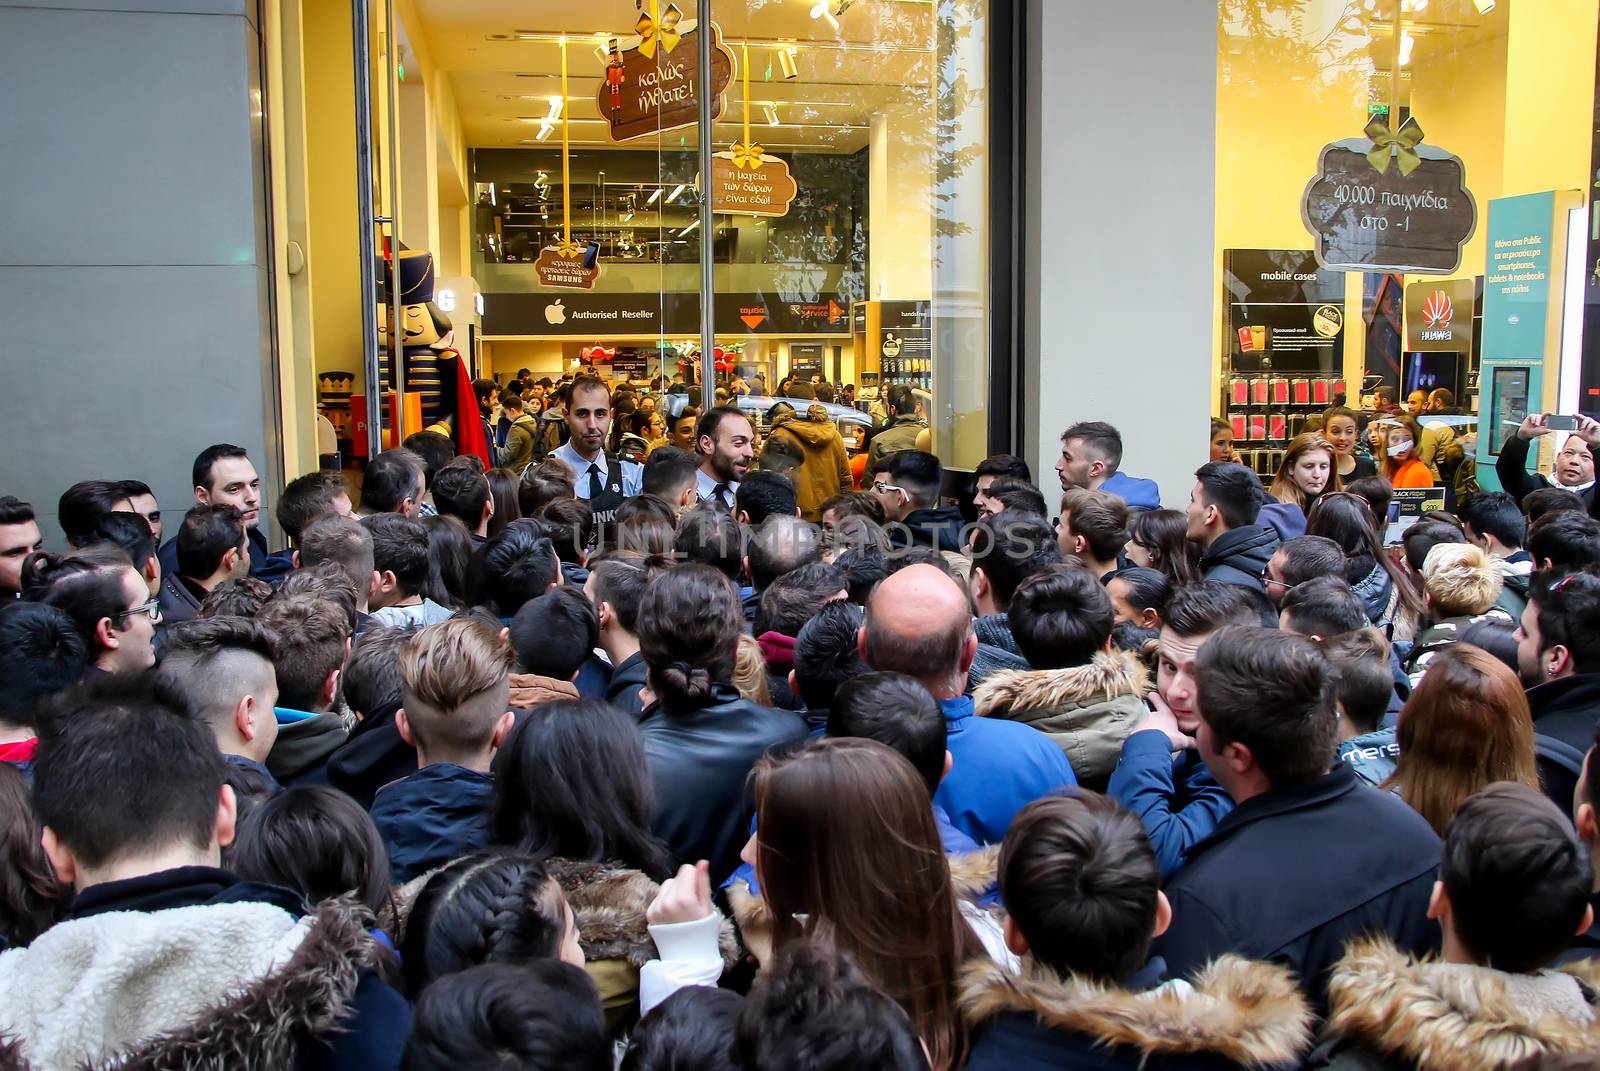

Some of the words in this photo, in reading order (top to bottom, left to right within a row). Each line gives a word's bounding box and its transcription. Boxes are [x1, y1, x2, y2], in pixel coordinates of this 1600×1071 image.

[638, 60, 684, 87] καλώς
[638, 80, 694, 114] ήλθατε!
[729, 171, 735, 181] η
[737, 170, 768, 182] μαγεία
[724, 182, 741, 191] των
[743, 181, 773, 194] δώρων
[726, 193, 748, 203] είναι
[750, 194, 771, 205] εδώ!
[1380, 189, 1449, 212] παιχνίδια
[1360, 216, 1389, 231] στο
[1396, 215, 1409, 232] -1
[547, 274, 583, 283] SAMSUNG
[1260, 270, 1292, 281] mobile
[1293, 273, 1318, 281] cases
[571, 310, 618, 319] Authorised
[621, 310, 654, 319] Reseller
[1421, 331, 1452, 341] HUAWEI
